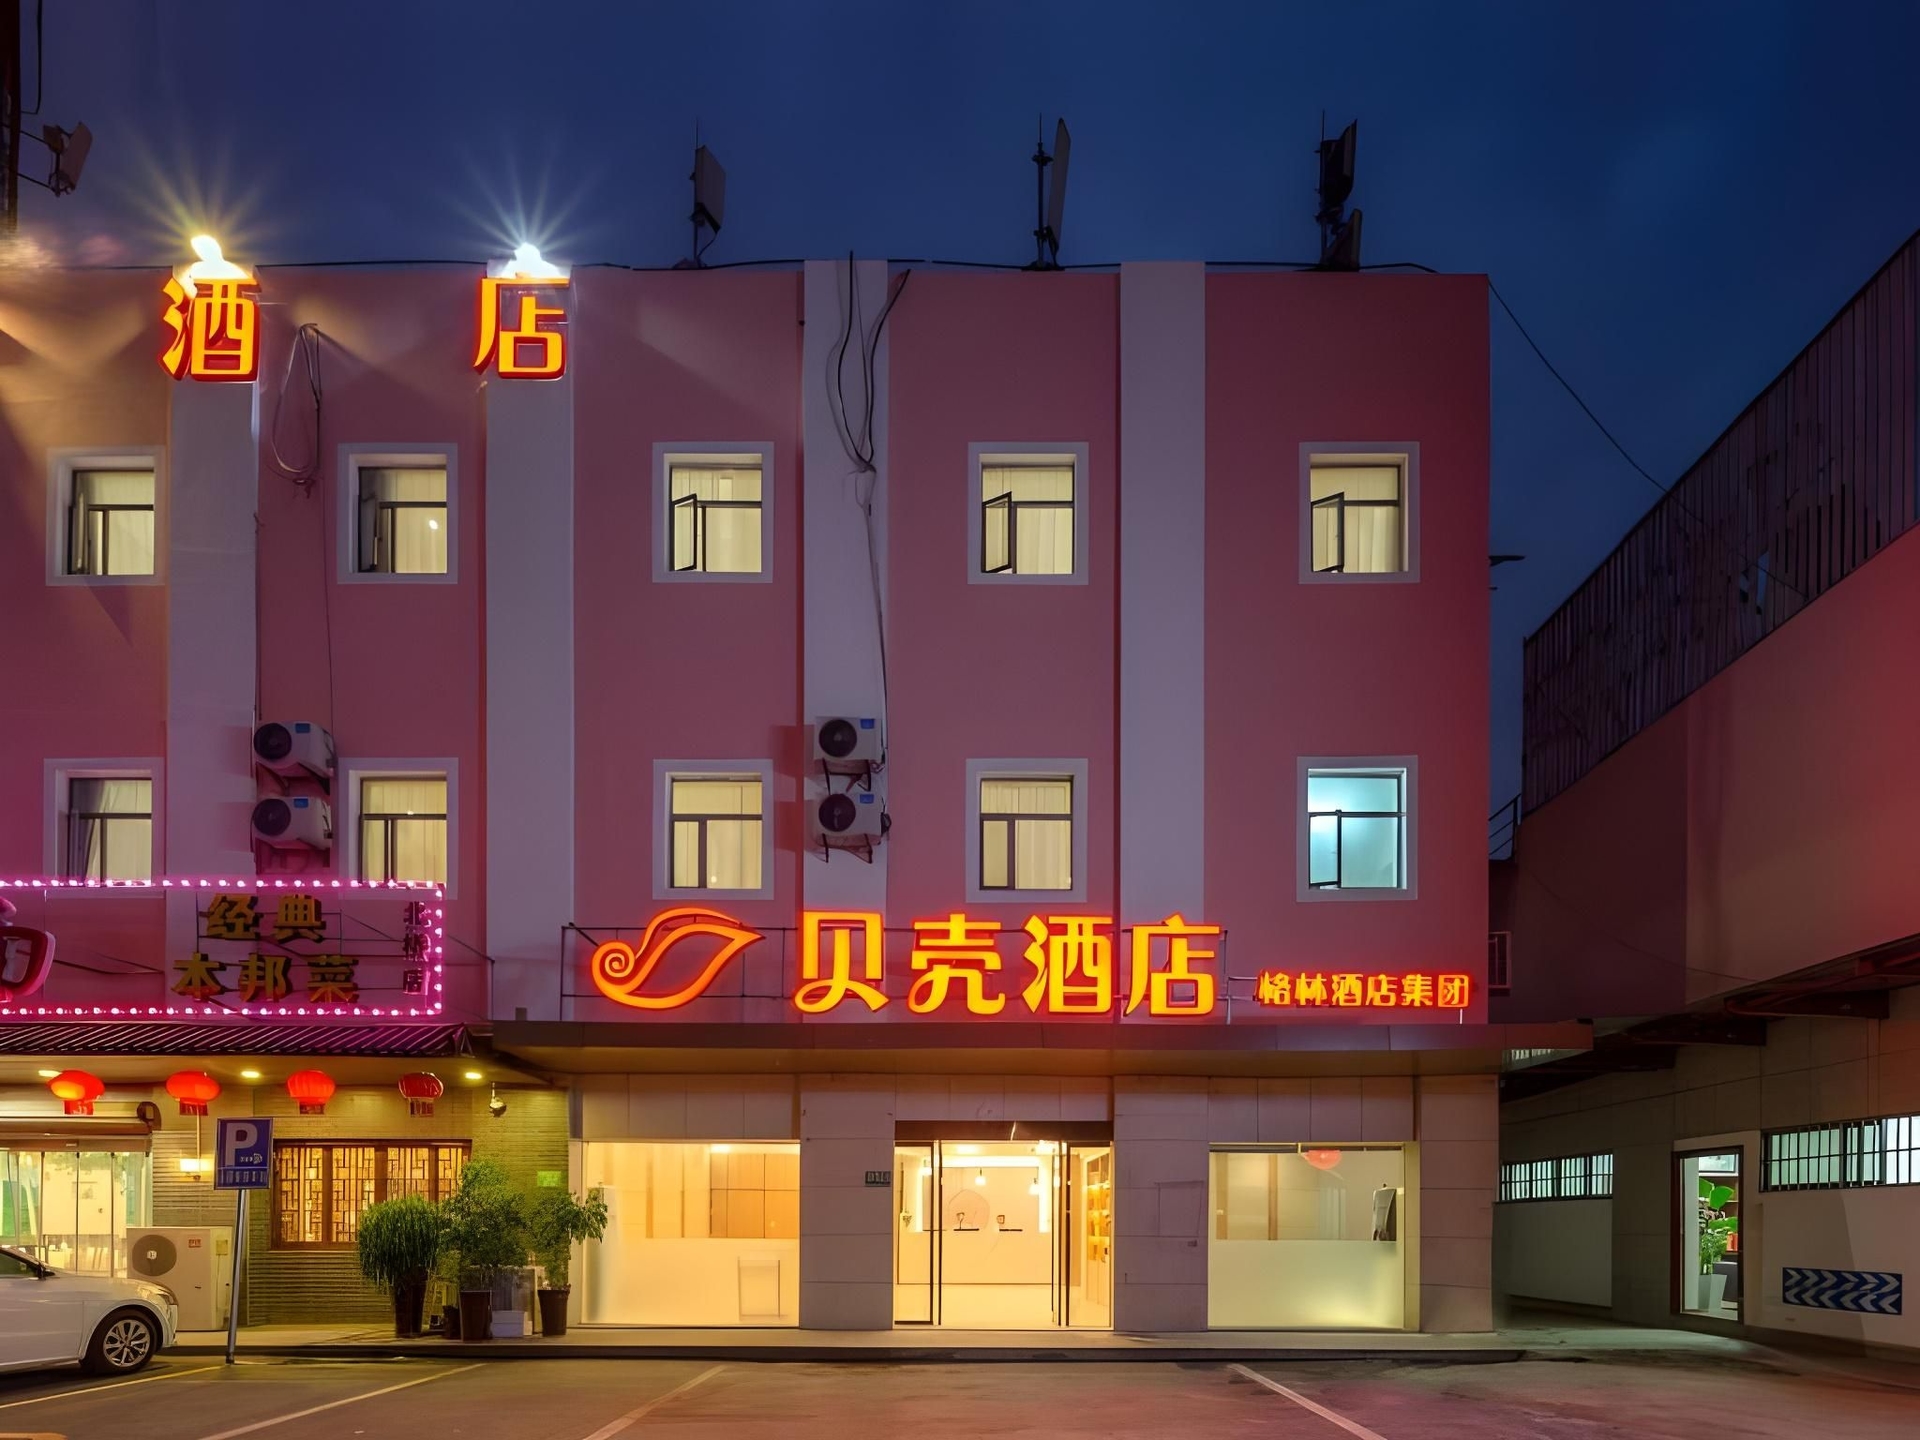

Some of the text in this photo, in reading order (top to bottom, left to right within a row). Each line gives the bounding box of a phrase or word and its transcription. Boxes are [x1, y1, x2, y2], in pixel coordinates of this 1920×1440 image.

[161, 271, 570, 380] 酒 店
[206, 893, 326, 943] 经典
[171, 952, 359, 1003] 本邦菜
[794, 912, 1220, 1016] 贝壳酒店
[1258, 971, 1470, 1008] 格林酒店集团
[225, 1122, 258, 1167] P
